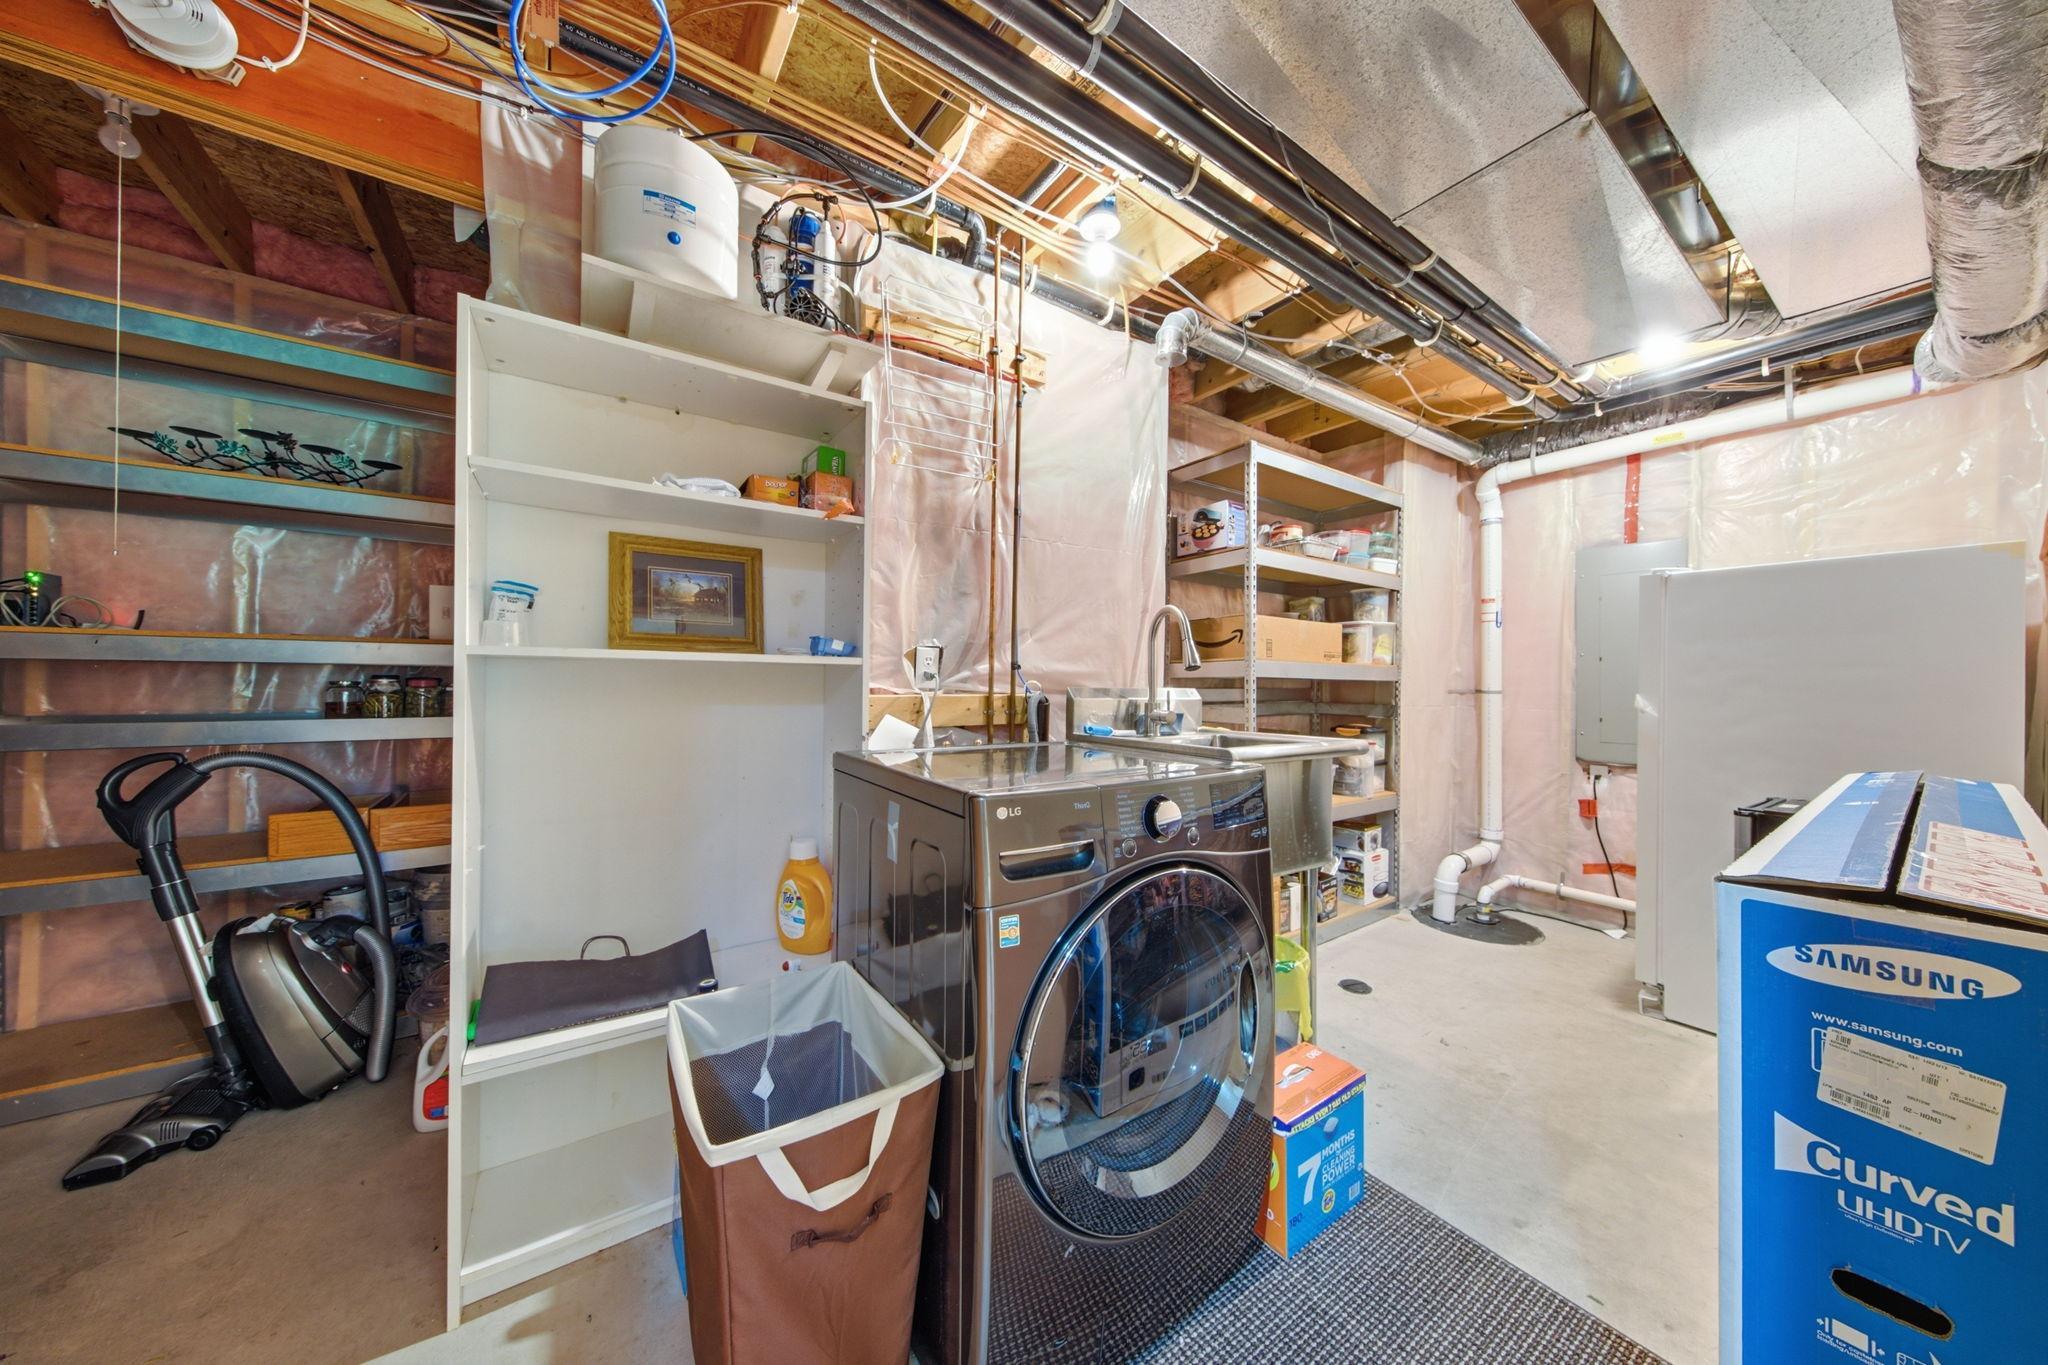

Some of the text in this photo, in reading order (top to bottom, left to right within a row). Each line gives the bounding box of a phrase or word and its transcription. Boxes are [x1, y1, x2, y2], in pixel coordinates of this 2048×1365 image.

[1009, 806, 1022, 817] LG
[1073, 801, 1091, 809] ThinQ
[783, 891, 795, 904] Tide
[1794, 943, 1985, 1001] SAMSUNG
[1811, 1011, 1964, 1058] www.samsung.com
[1321, 1129, 1356, 1160] MONTHS
[1322, 1145, 1356, 1174] CLEANING
[1297, 1151, 1322, 1206] 7
[1322, 1154, 1356, 1187] POWER
[1806, 1140, 2016, 1248] Curved
